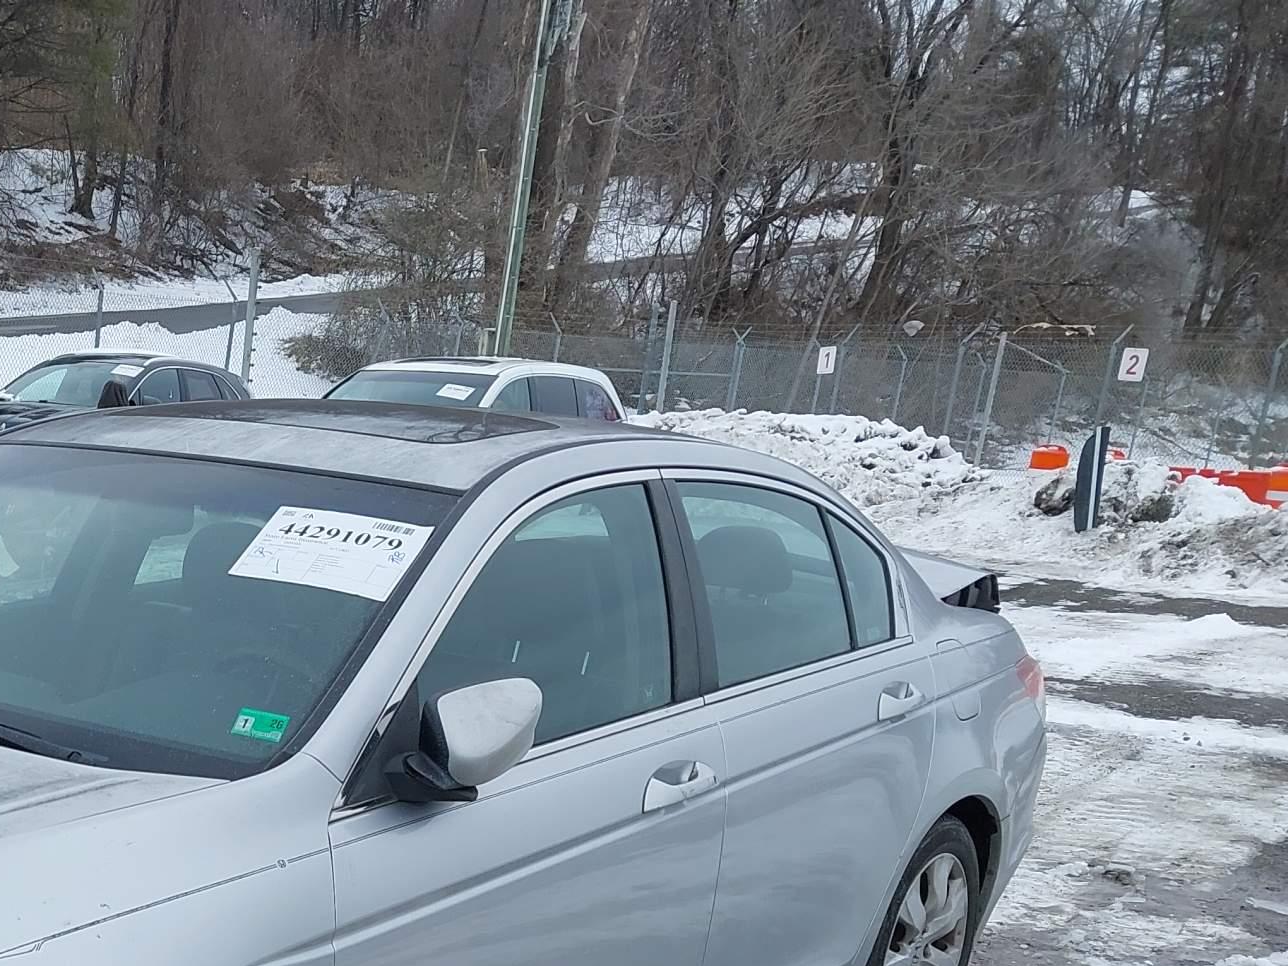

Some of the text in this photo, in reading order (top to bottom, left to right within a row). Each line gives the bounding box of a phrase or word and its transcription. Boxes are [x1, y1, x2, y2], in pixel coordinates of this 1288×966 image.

[823, 351, 831, 369] 1
[1125, 355, 1141, 375] 2
[278, 522, 403, 551] 44291079
[241, 718, 284, 729] 1 26
